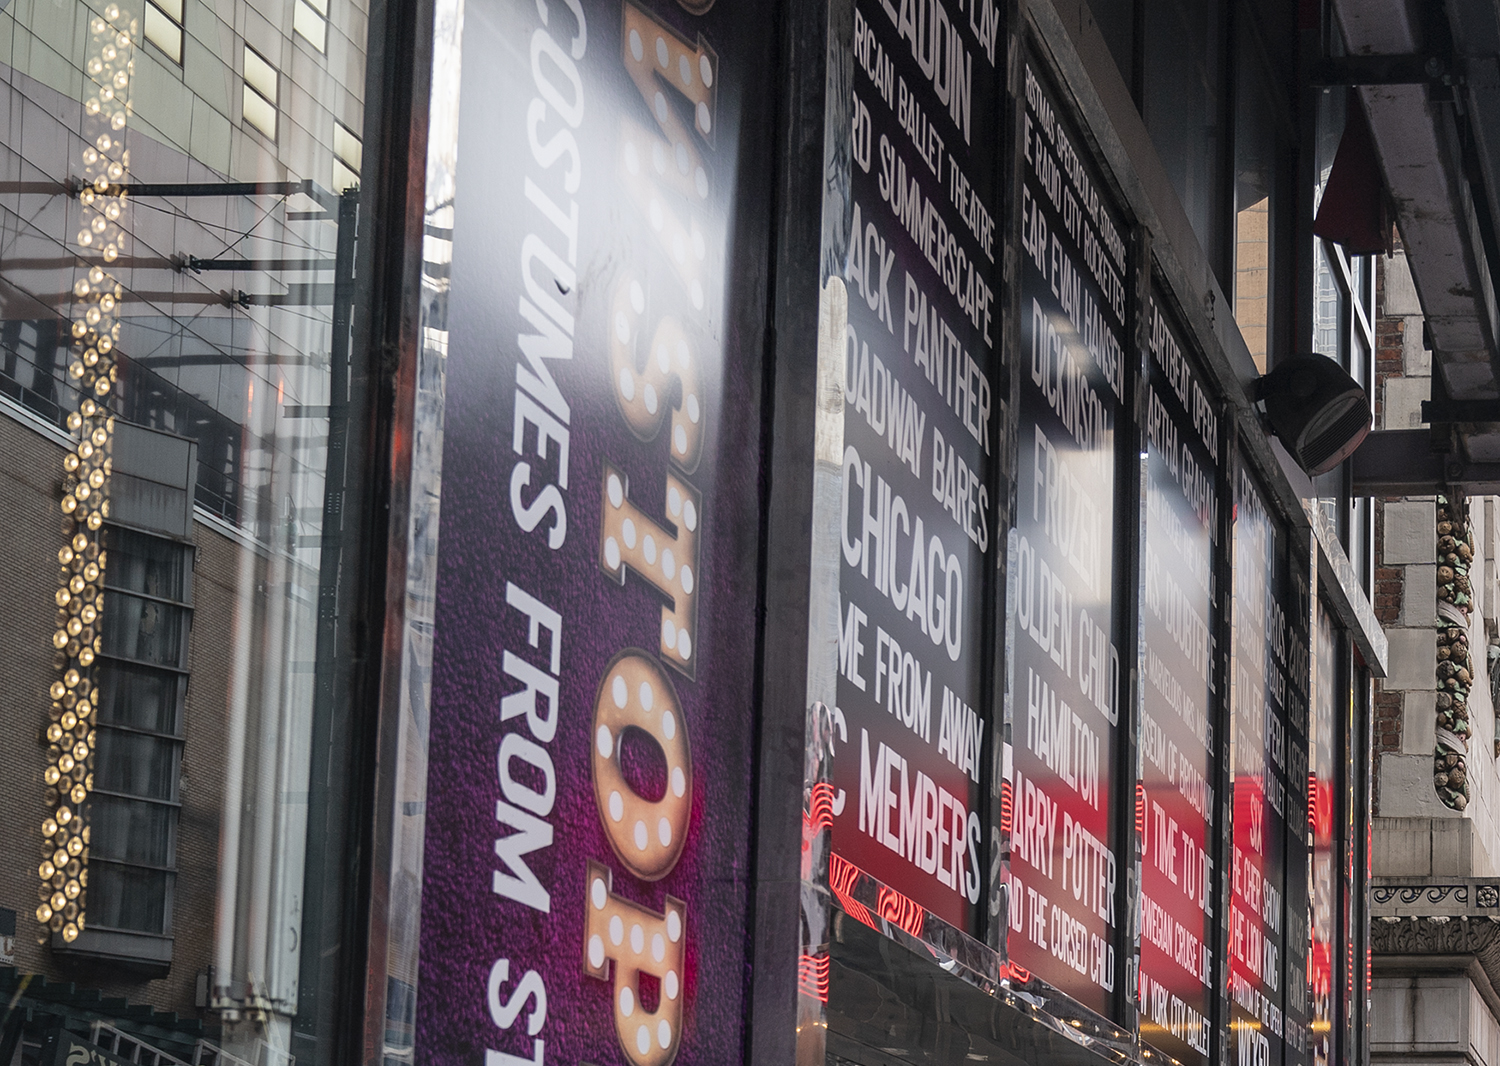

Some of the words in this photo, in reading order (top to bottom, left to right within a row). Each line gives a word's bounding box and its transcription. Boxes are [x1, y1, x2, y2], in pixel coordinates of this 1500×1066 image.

[958, 0, 1000, 68] LAY
[854, 7, 895, 111] RICAN
[898, 75, 945, 184] BALLET
[948, 153, 996, 265] THEATRE
[1056, 123, 1100, 229] SPECTACULAR
[510, 0, 587, 550] COSTUMES
[878, 133, 995, 350] SUMMERSCAPE
[1035, 132, 1062, 213] RADIO
[1063, 191, 1083, 250] CITY
[1083, 219, 1127, 327] ROCKETTES
[1022, 183, 1048, 281] EAR
[1051, 232, 1082, 335] EVAN
[1083, 288, 1126, 406] HANSEN
[903, 270, 991, 457] PANTHER
[1031, 297, 1110, 484] DICKINSON
[1192, 379, 1219, 467] OPERA
[845, 323, 926, 479] OADWAY
[932, 425, 990, 554] BARES
[1182, 442, 1219, 547] GRAHAM
[840, 444, 964, 662] CHICAGO
[1033, 423, 1103, 601] FROZEN
[875, 625, 932, 744] FROM
[937, 684, 986, 785] AWAY
[1078, 608, 1121, 728] CHILD
[1148, 645, 1182, 718] MARVELOUS
[492, 579, 563, 914] FROM
[1026, 667, 1100, 812] HAMILTON
[1168, 738, 1178, 787] OF
[1179, 753, 1215, 828] BROADWAY
[1263, 700, 1286, 776] OPERA
[858, 727, 982, 906] MEMBERS
[1061, 812, 1118, 930] POTTER
[1152, 799, 1179, 887] TIME
[1181, 829, 1196, 902] TO
[1198, 845, 1214, 919] DIE
[1249, 793, 1264, 857] SIX
[1027, 886, 1048, 951] THE
[1050, 903, 1089, 976] CURSED
[1089, 932, 1116, 994] CHILD
[1174, 920, 1198, 979] CRUISE
[1198, 941, 1213, 990] LINE
[1243, 855, 1261, 917] CHER
[1262, 877, 1282, 935] SHOW
[1246, 915, 1262, 979] LION
[1262, 935, 1279, 994] KING
[1150, 976, 1169, 1032] YORK
[1170, 993, 1186, 1043] CITY
[1187, 1005, 1212, 1059] BALLET
